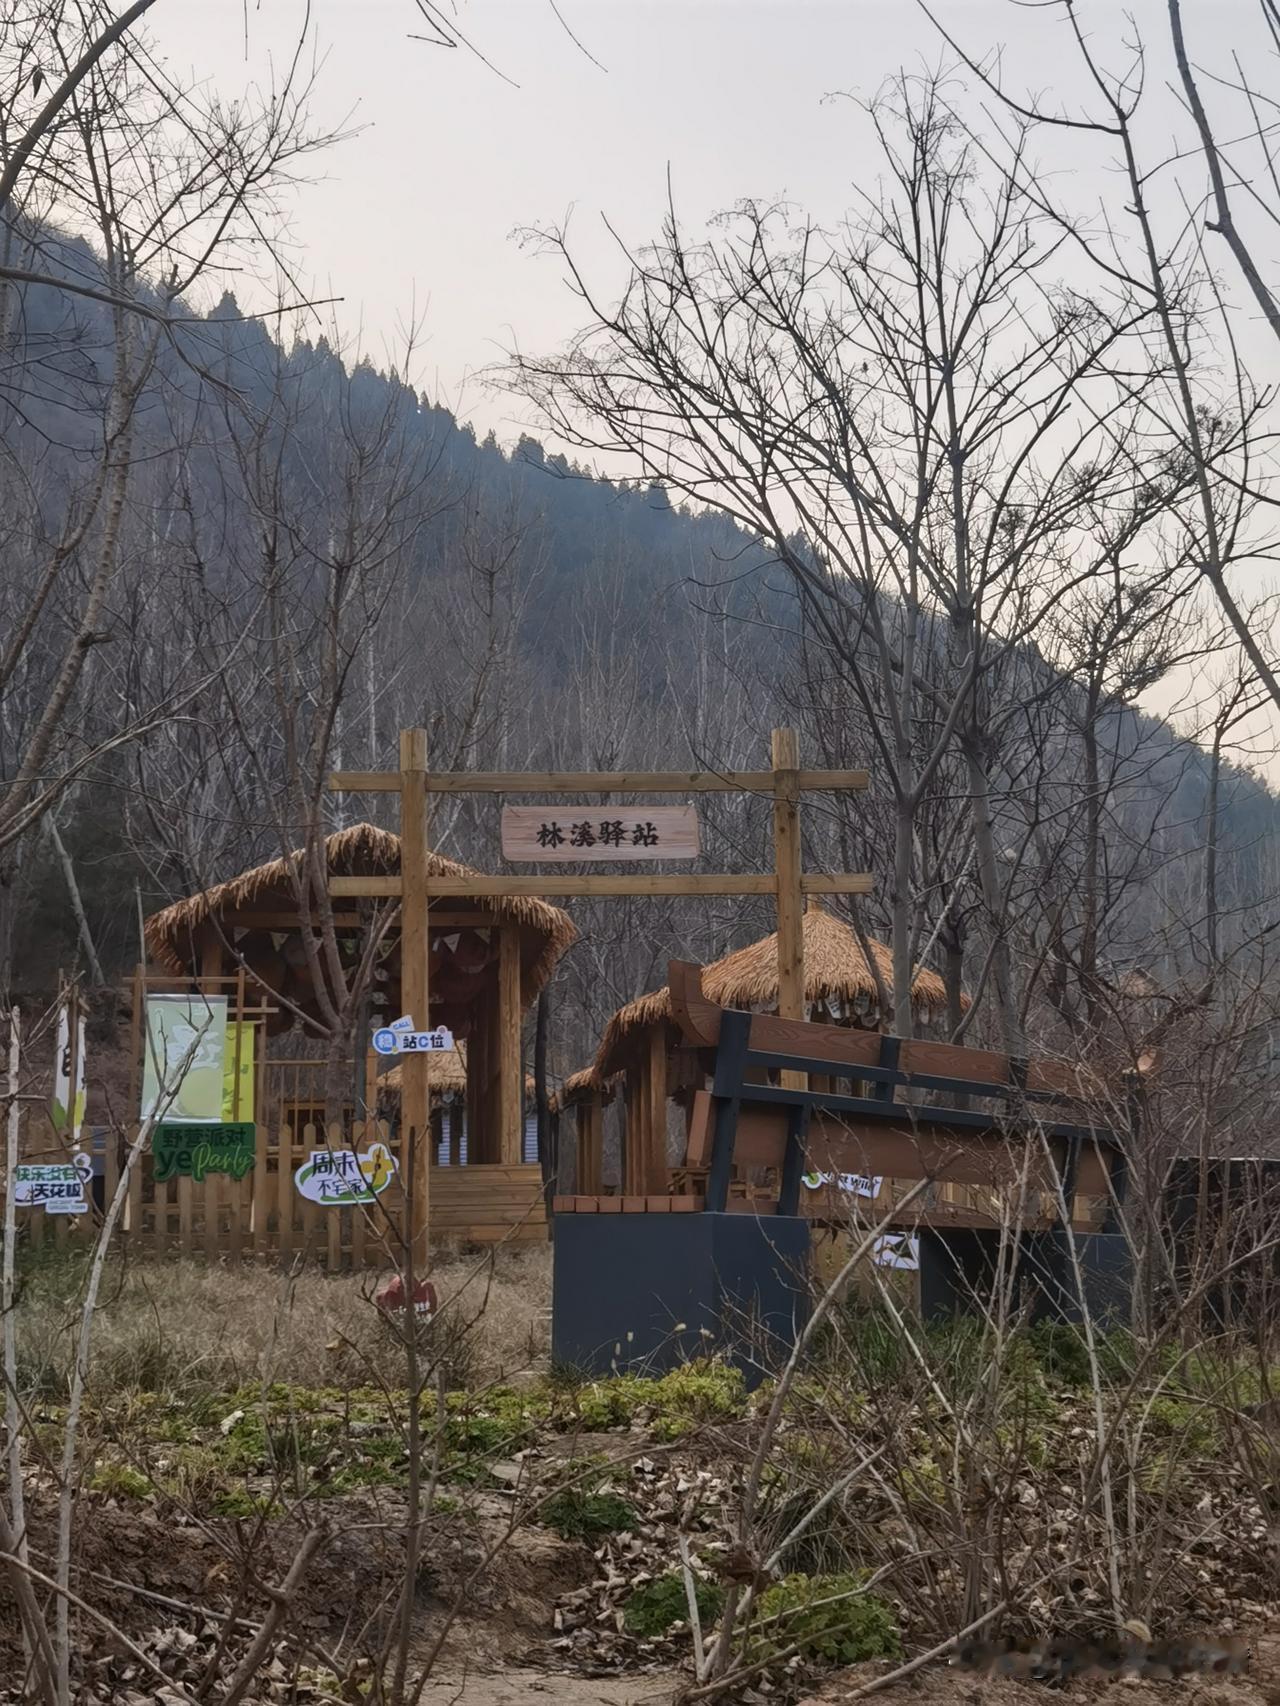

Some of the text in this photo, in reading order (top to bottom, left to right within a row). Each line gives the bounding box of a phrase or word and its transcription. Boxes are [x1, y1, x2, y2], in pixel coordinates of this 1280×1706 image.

[536, 820, 659, 849] 林溪驿站
[162, 1127, 247, 1148] 野营派对
[16, 1166, 76, 1181] 快乐没有
[312, 1152, 361, 1177] 周末
[34, 1183, 81, 1199] 天花板
[317, 1178, 364, 1197] 不宅家
